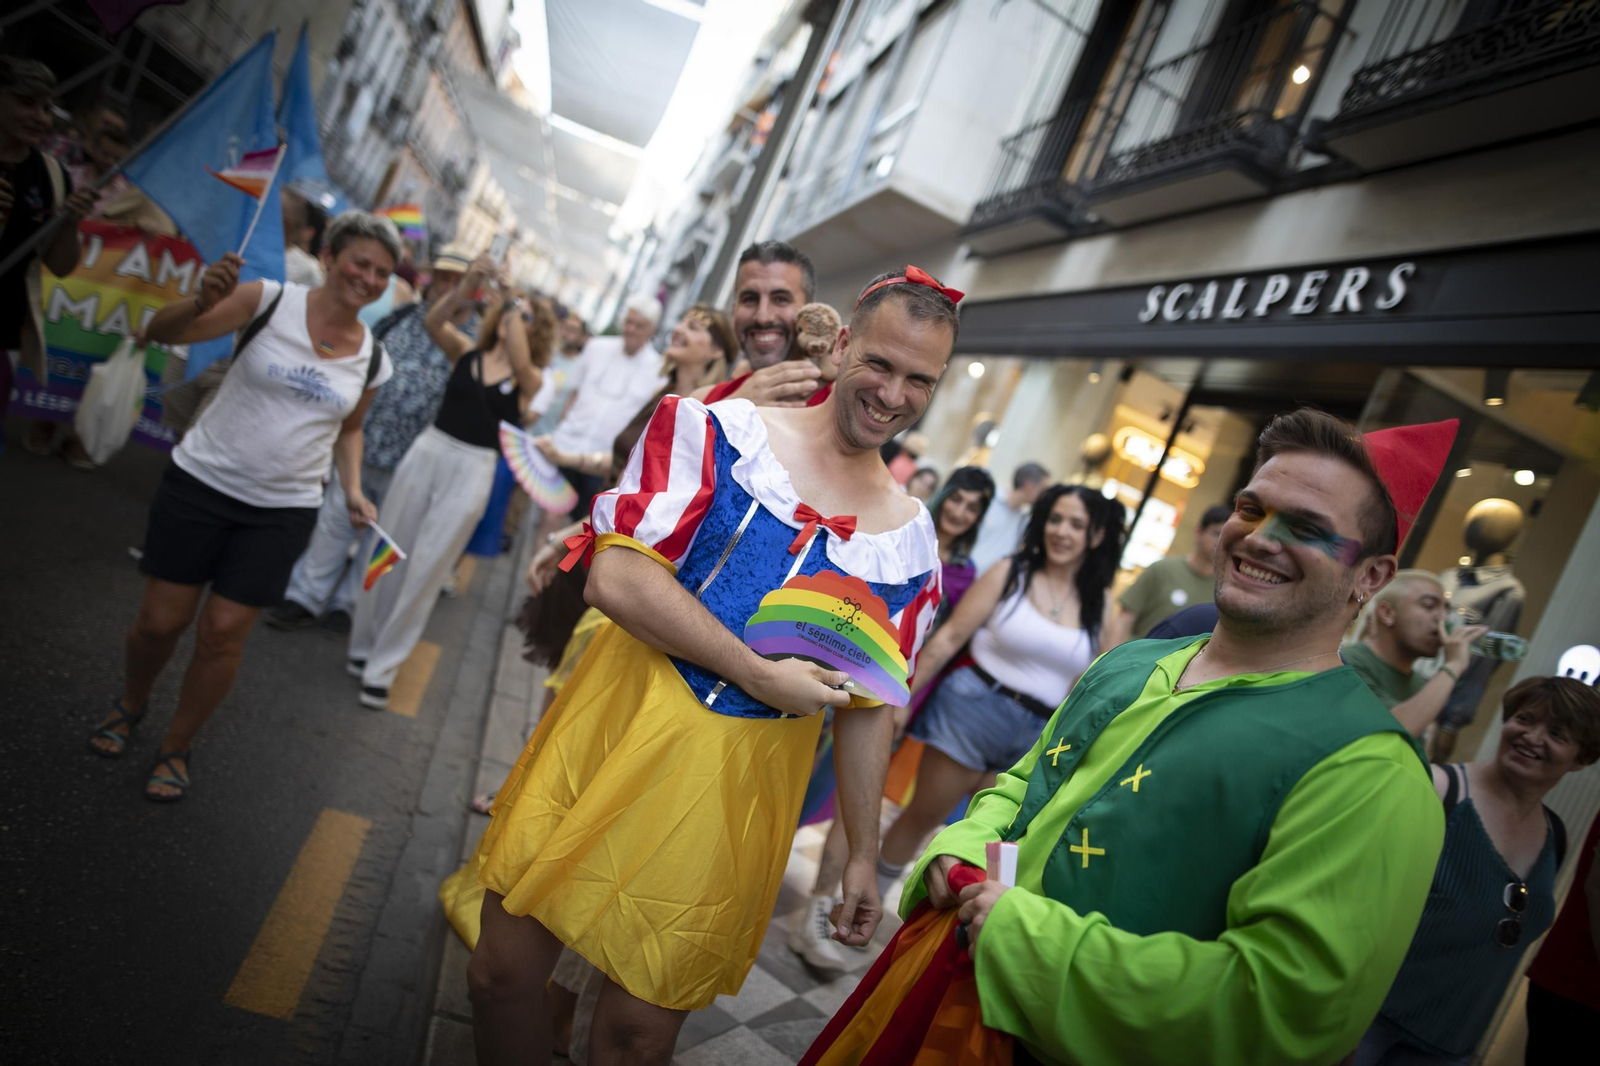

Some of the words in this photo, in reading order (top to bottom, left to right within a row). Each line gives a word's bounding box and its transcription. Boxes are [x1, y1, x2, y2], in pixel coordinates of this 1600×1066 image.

[1138, 262, 1416, 323] SCALPERS
[795, 621, 807, 632] el
[808, 627, 847, 652] séptimo
[848, 648, 872, 664] cielo
[798, 633, 818, 646] CRUISING
[819, 644, 833, 653] FETISH
[833, 650, 844, 659] CLUB
[844, 656, 866, 669] GRANADA
